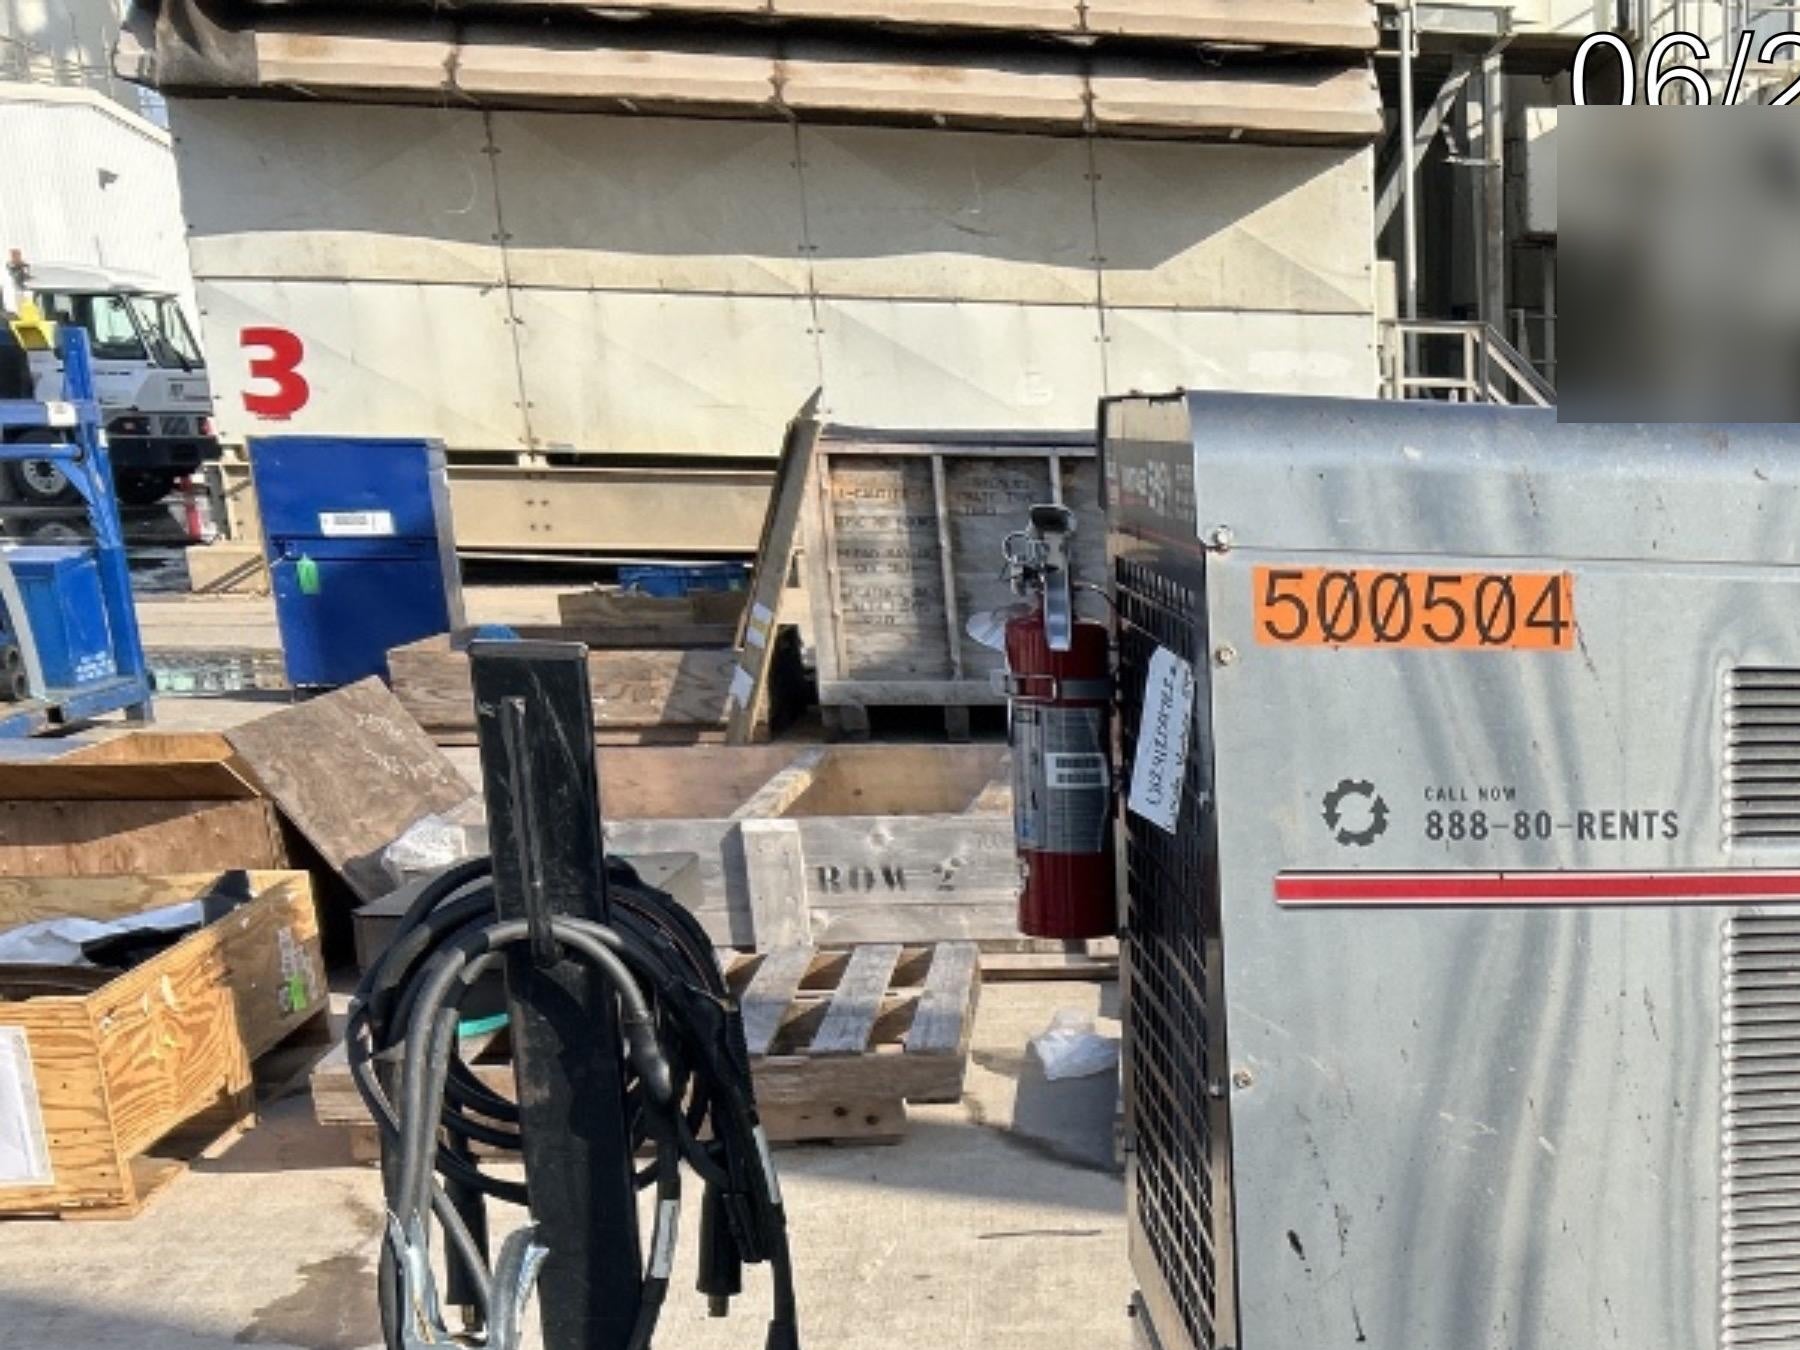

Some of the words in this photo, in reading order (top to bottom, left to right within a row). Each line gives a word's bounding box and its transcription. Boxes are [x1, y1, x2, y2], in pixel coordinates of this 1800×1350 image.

[240, 327, 309, 421] 3
[1264, 569, 1570, 645] 500504
[1424, 786, 1468, 801] CALL
[1478, 786, 1517, 801] NOW
[1425, 809, 1680, 841] 888-80-RENTS
[816, 865, 906, 893] ROW
